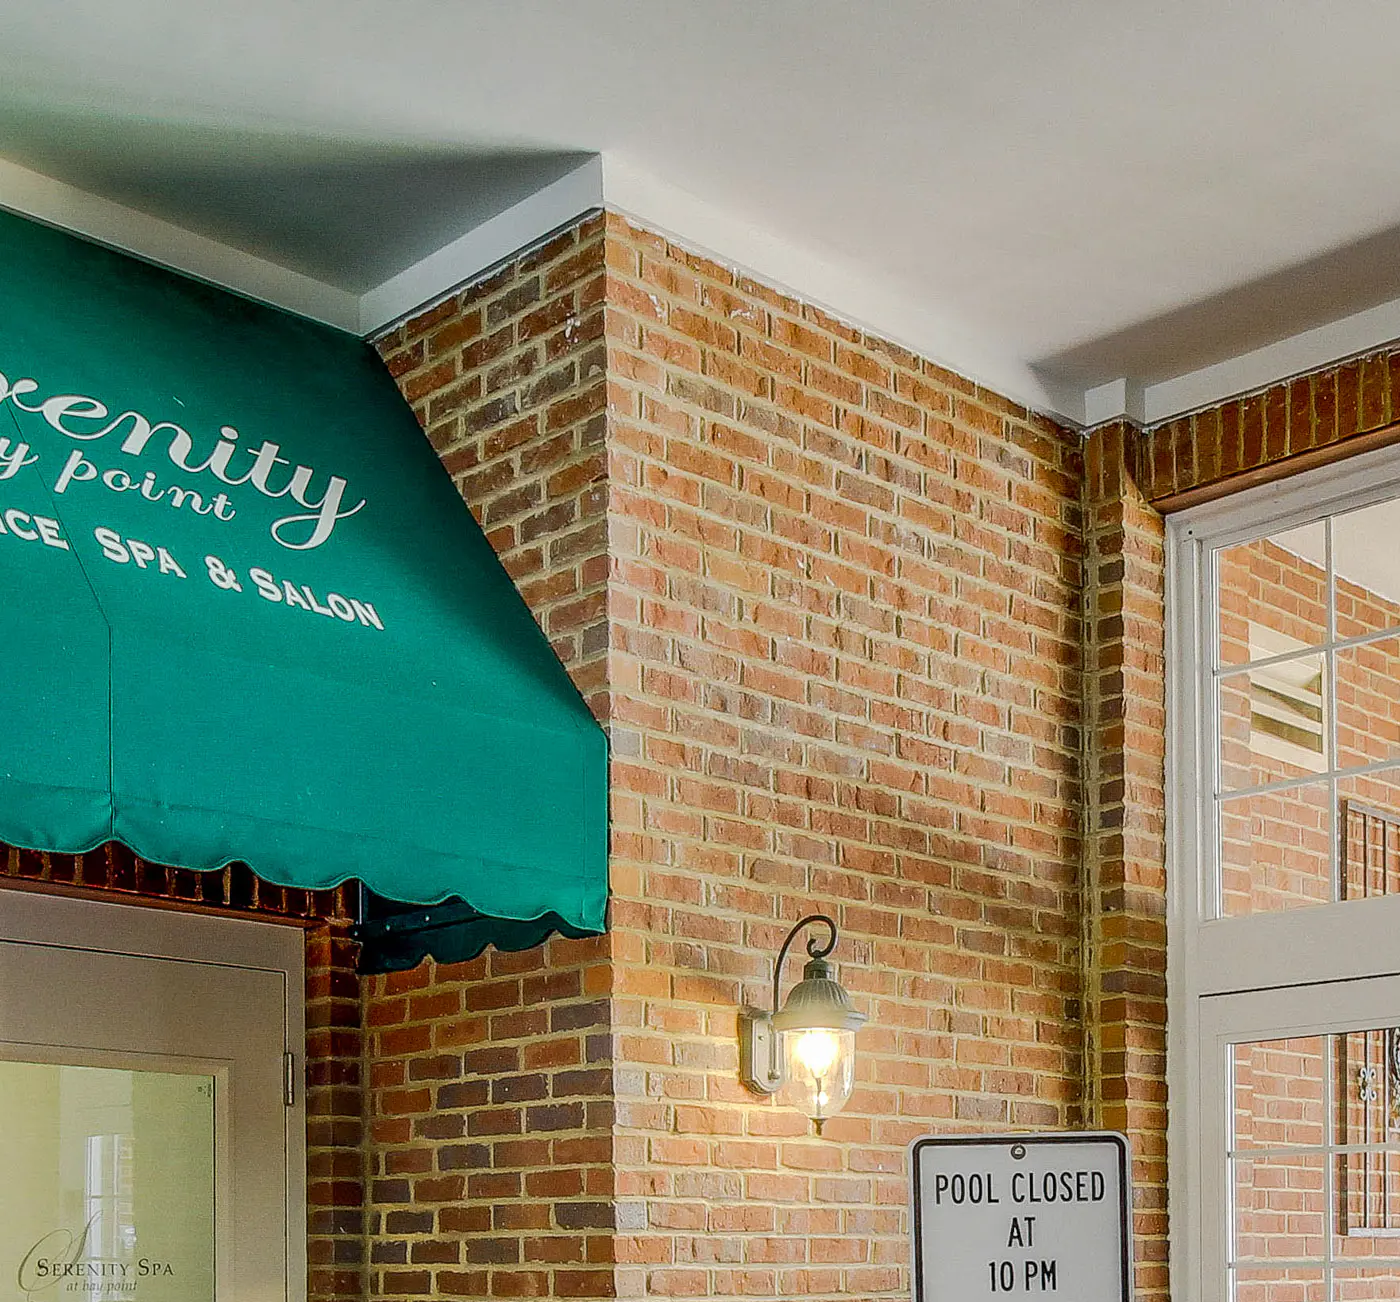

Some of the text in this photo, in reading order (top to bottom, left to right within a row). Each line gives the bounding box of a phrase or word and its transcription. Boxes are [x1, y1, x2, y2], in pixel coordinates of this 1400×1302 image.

[54, 449, 236, 522] point
[93, 527, 187, 579] SPA
[204, 554, 243, 593] &
[249, 567, 386, 631] SALON
[935, 1171, 1105, 1205] POOL CLOSED
[1007, 1216, 1036, 1248] AT
[37, 1258, 175, 1277] SERENITY SPA
[988, 1259, 1057, 1292] 10 PM
[66, 1279, 138, 1294] at bay point
